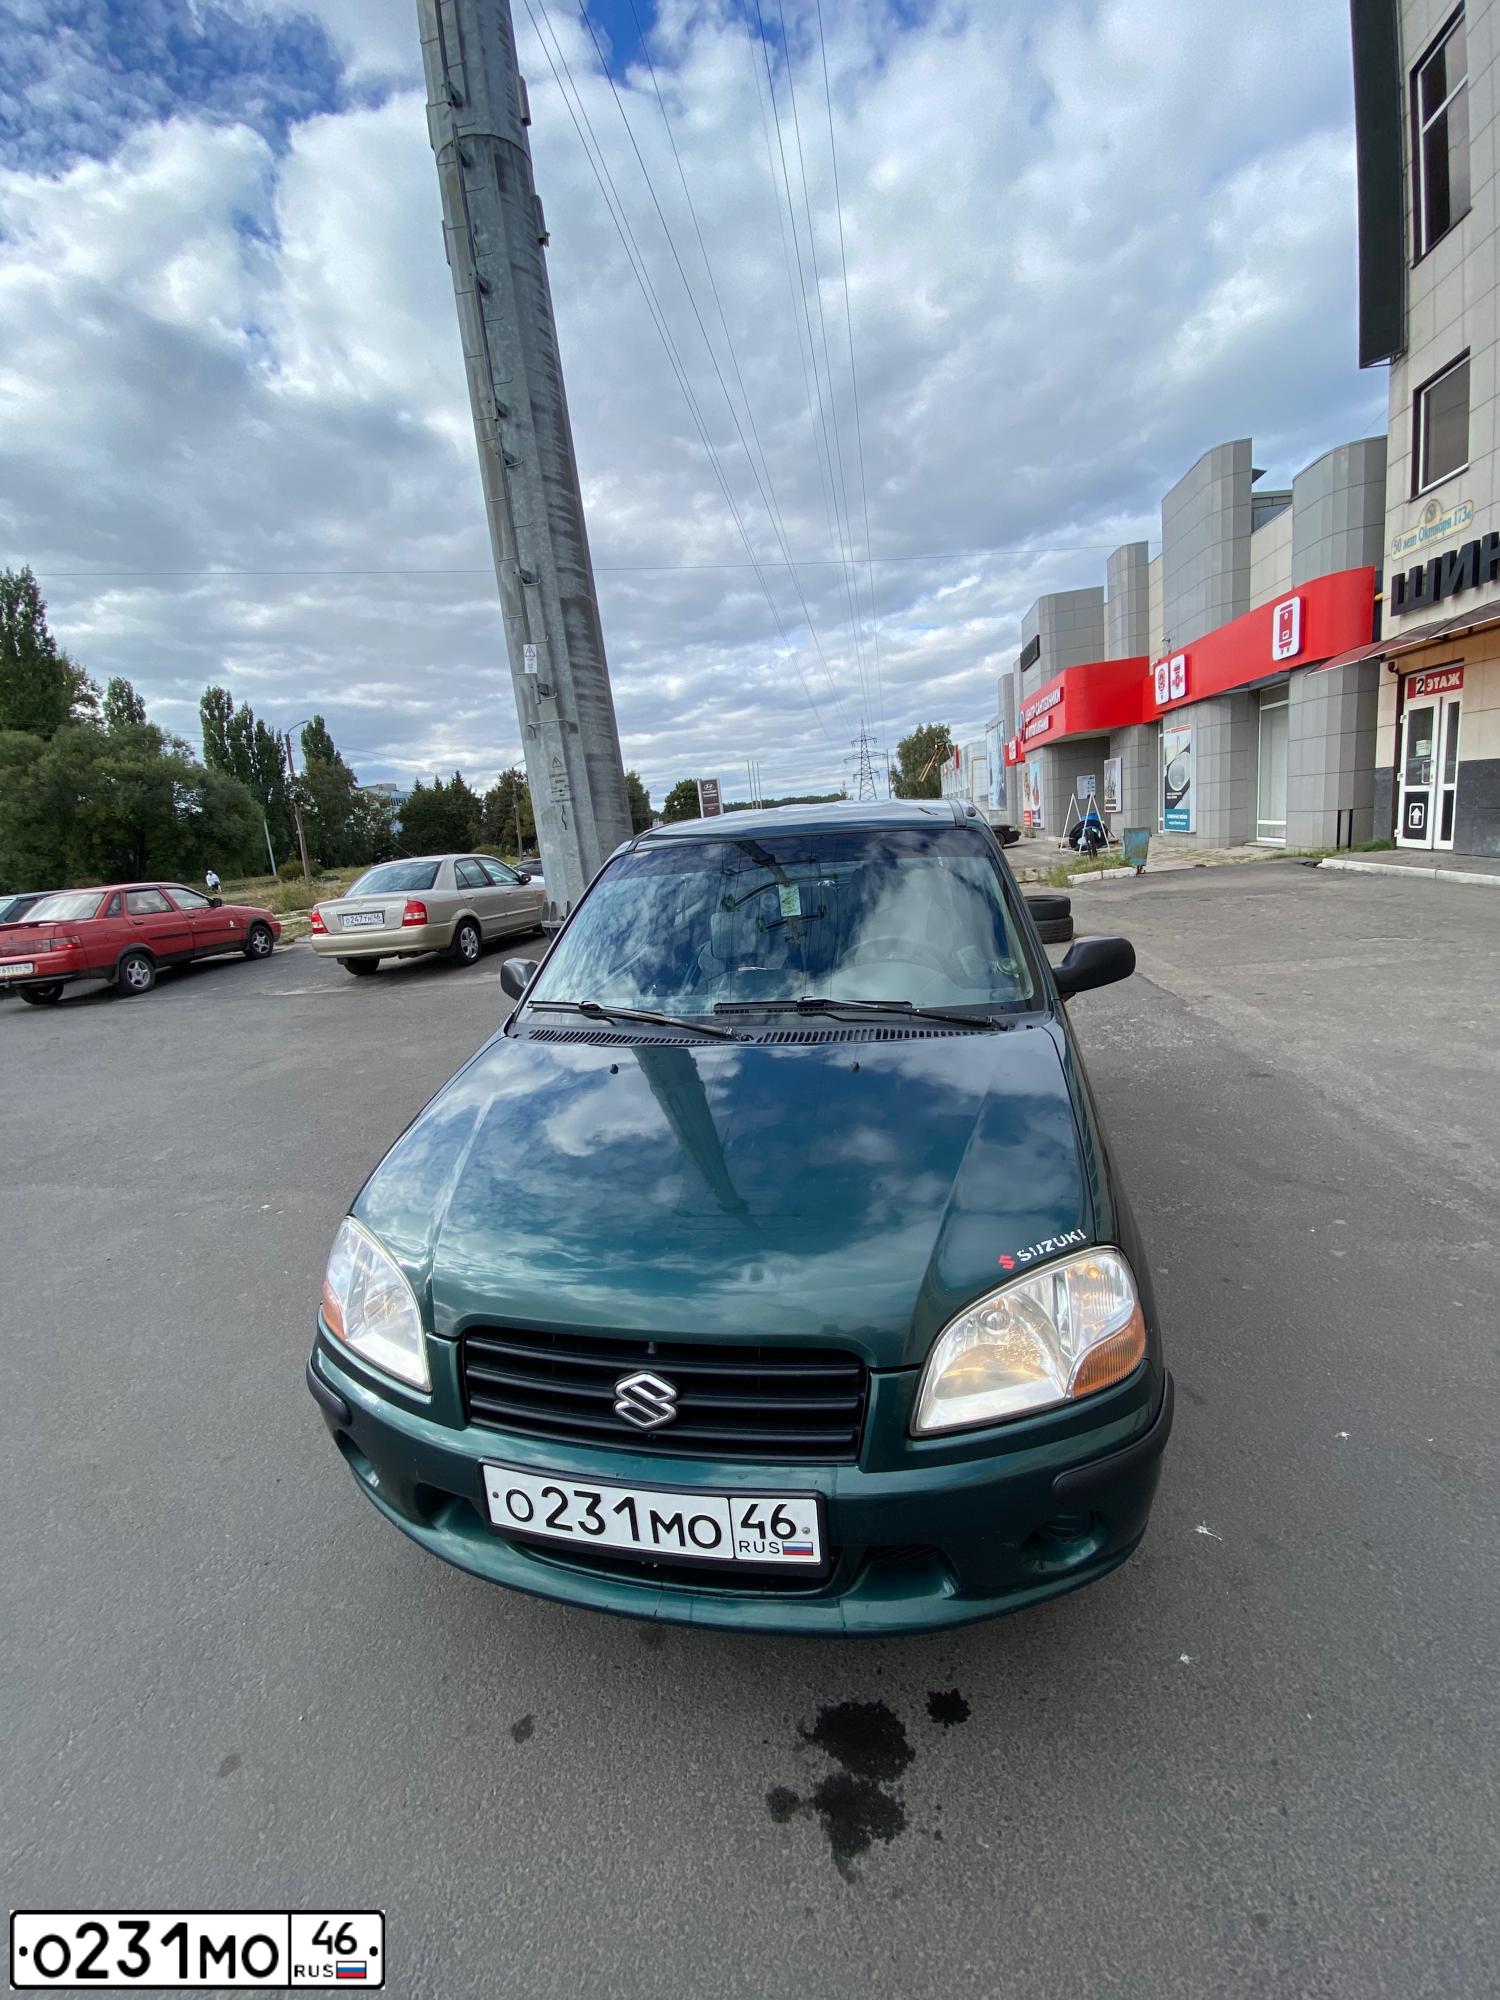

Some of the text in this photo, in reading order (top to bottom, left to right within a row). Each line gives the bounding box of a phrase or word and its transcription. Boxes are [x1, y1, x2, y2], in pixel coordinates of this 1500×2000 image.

[1416, 672, 1460, 694] 2 ЭТАЖ
[505, 1486, 797, 1550] О231МО 46
[738, 1540, 781, 1555] RUS
